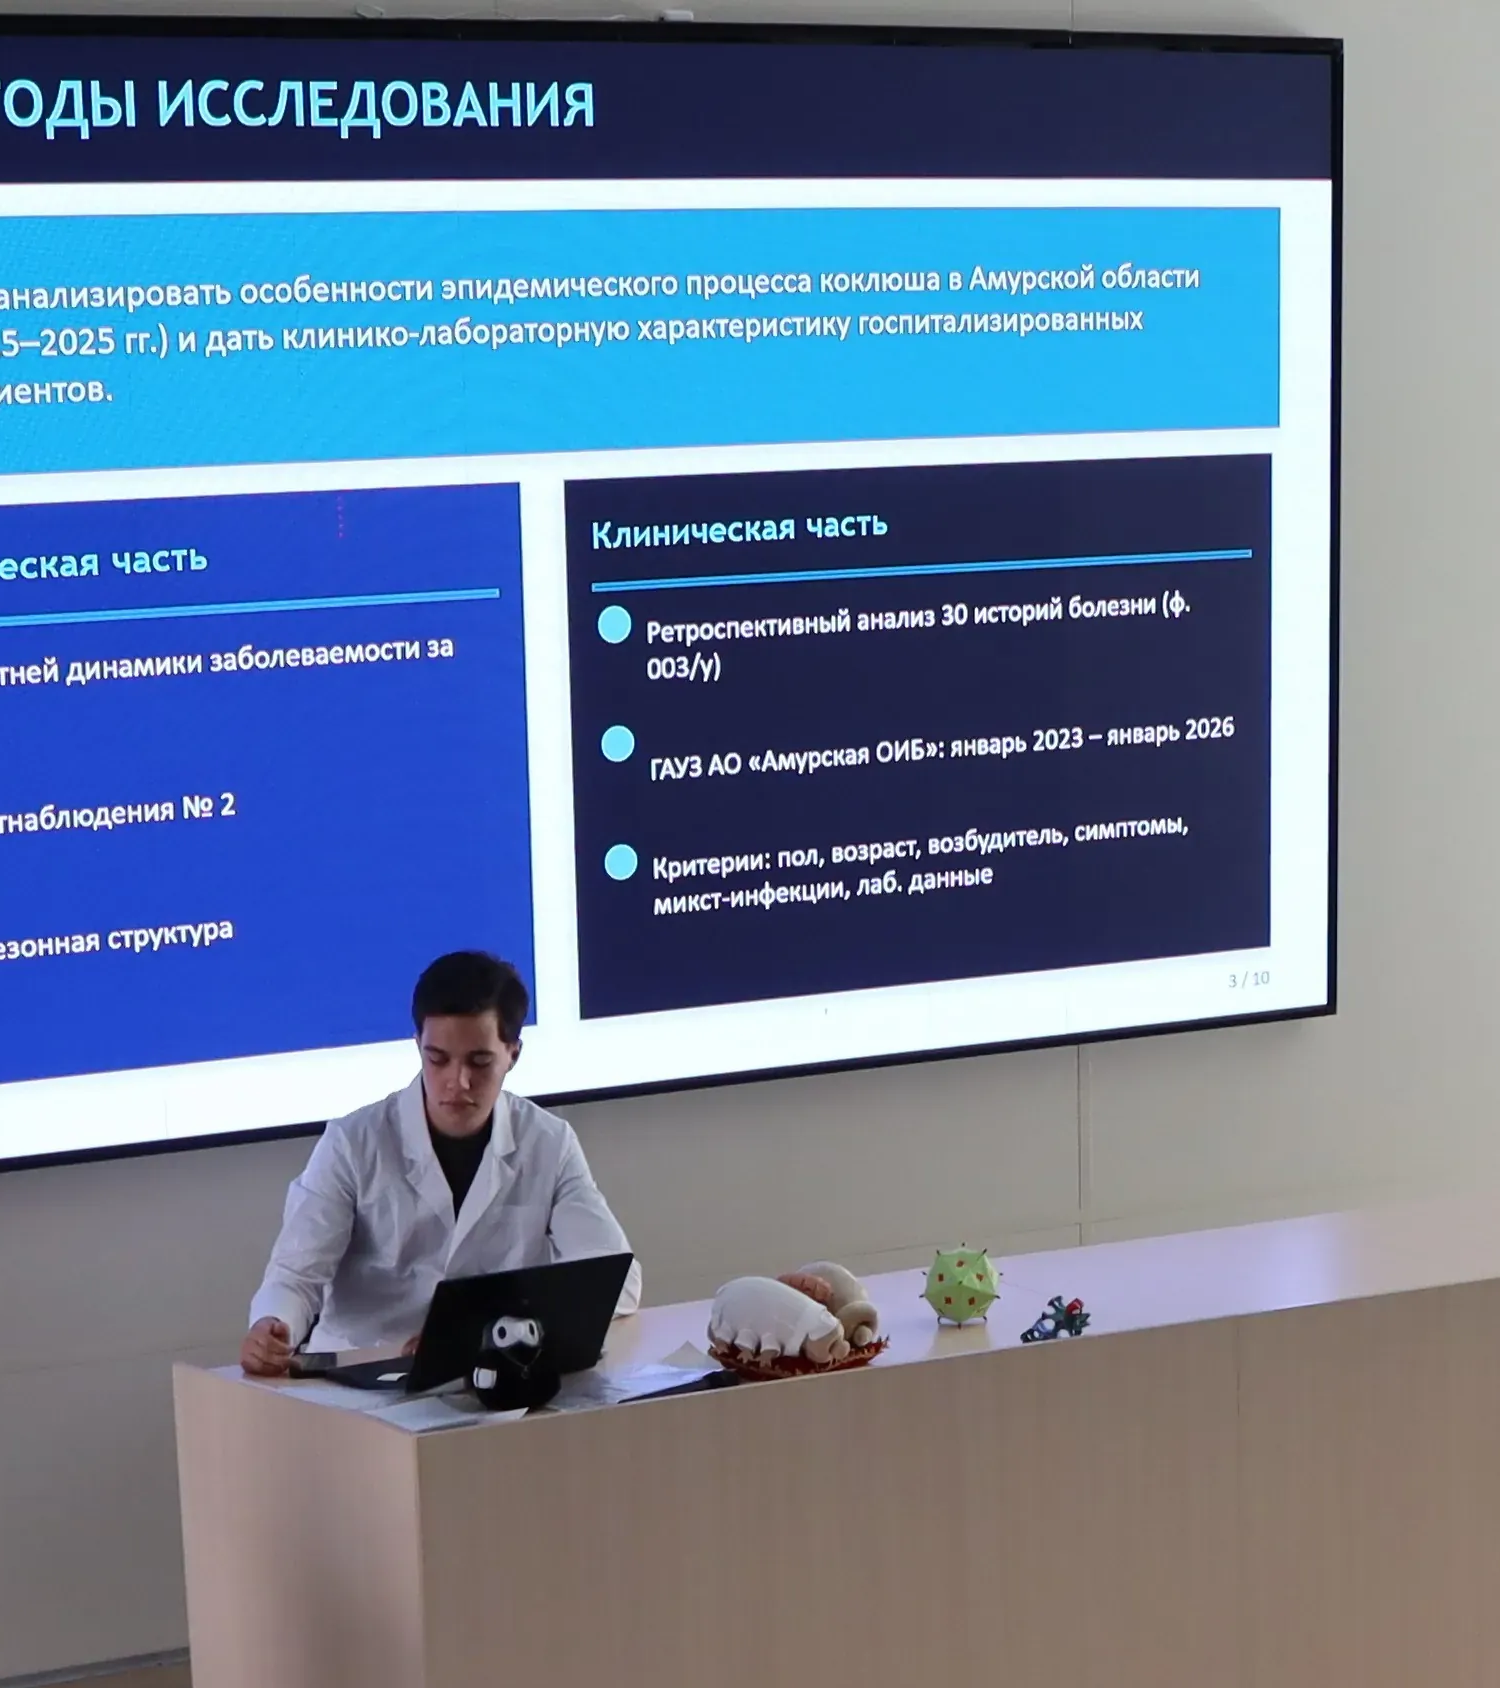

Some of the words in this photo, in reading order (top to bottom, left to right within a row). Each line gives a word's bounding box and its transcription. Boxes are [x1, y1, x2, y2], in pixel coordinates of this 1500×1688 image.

[158, 79, 594, 140] ИССЛЕДОВАНИЯ
[240, 273, 433, 304] особенности
[441, 274, 678, 305] эпидемического
[686, 273, 812, 301] процесса
[820, 271, 941, 293] коклюша
[949, 271, 963, 291] в
[969, 263, 1095, 296] Амурской
[1101, 261, 1200, 289] области
[125, 322, 169, 359] гг.)
[178, 331, 196, 352] и
[205, 329, 274, 358] дать
[283, 315, 630, 350] клинико-лабораторную
[637, 315, 852, 345] характеристику
[859, 310, 1144, 337] госпитализированных
[592, 518, 795, 550] Клиническая
[806, 512, 888, 538] часть
[111, 546, 208, 575] часть
[647, 607, 851, 647] Ретроспективный
[857, 609, 936, 632] анализ
[941, 602, 969, 626] 30
[974, 596, 1063, 627] историй
[1068, 594, 1157, 619] болезни
[1162, 589, 1191, 619] (ф.
[65, 654, 203, 687] динамики
[209, 640, 420, 672] заболеваемости
[427, 638, 454, 658] за
[650, 754, 703, 782] ГАУЗ
[707, 752, 742, 777] АО
[748, 746, 870, 775] «Амурская
[876, 738, 945, 763] ОИБ»:
[950, 735, 1027, 759] январь
[1032, 726, 1084, 752] 2023
[1107, 724, 1181, 748] январь
[1185, 715, 1235, 741] 2026
[182, 795, 214, 819] №
[220, 792, 236, 817] 2
[653, 852, 771, 884] Критерии:
[777, 848, 825, 869] пол,
[831, 839, 922, 866] возраст,
[928, 827, 1069, 856] возбудитель,
[1074, 816, 1189, 842] симптомы,
[653, 880, 851, 916] микст-инфекции,
[856, 869, 903, 897] лаб.
[907, 867, 994, 896] данные
[107, 920, 234, 953] структура
[1228, 973, 1238, 989] 3
[1252, 970, 1271, 987] 10
